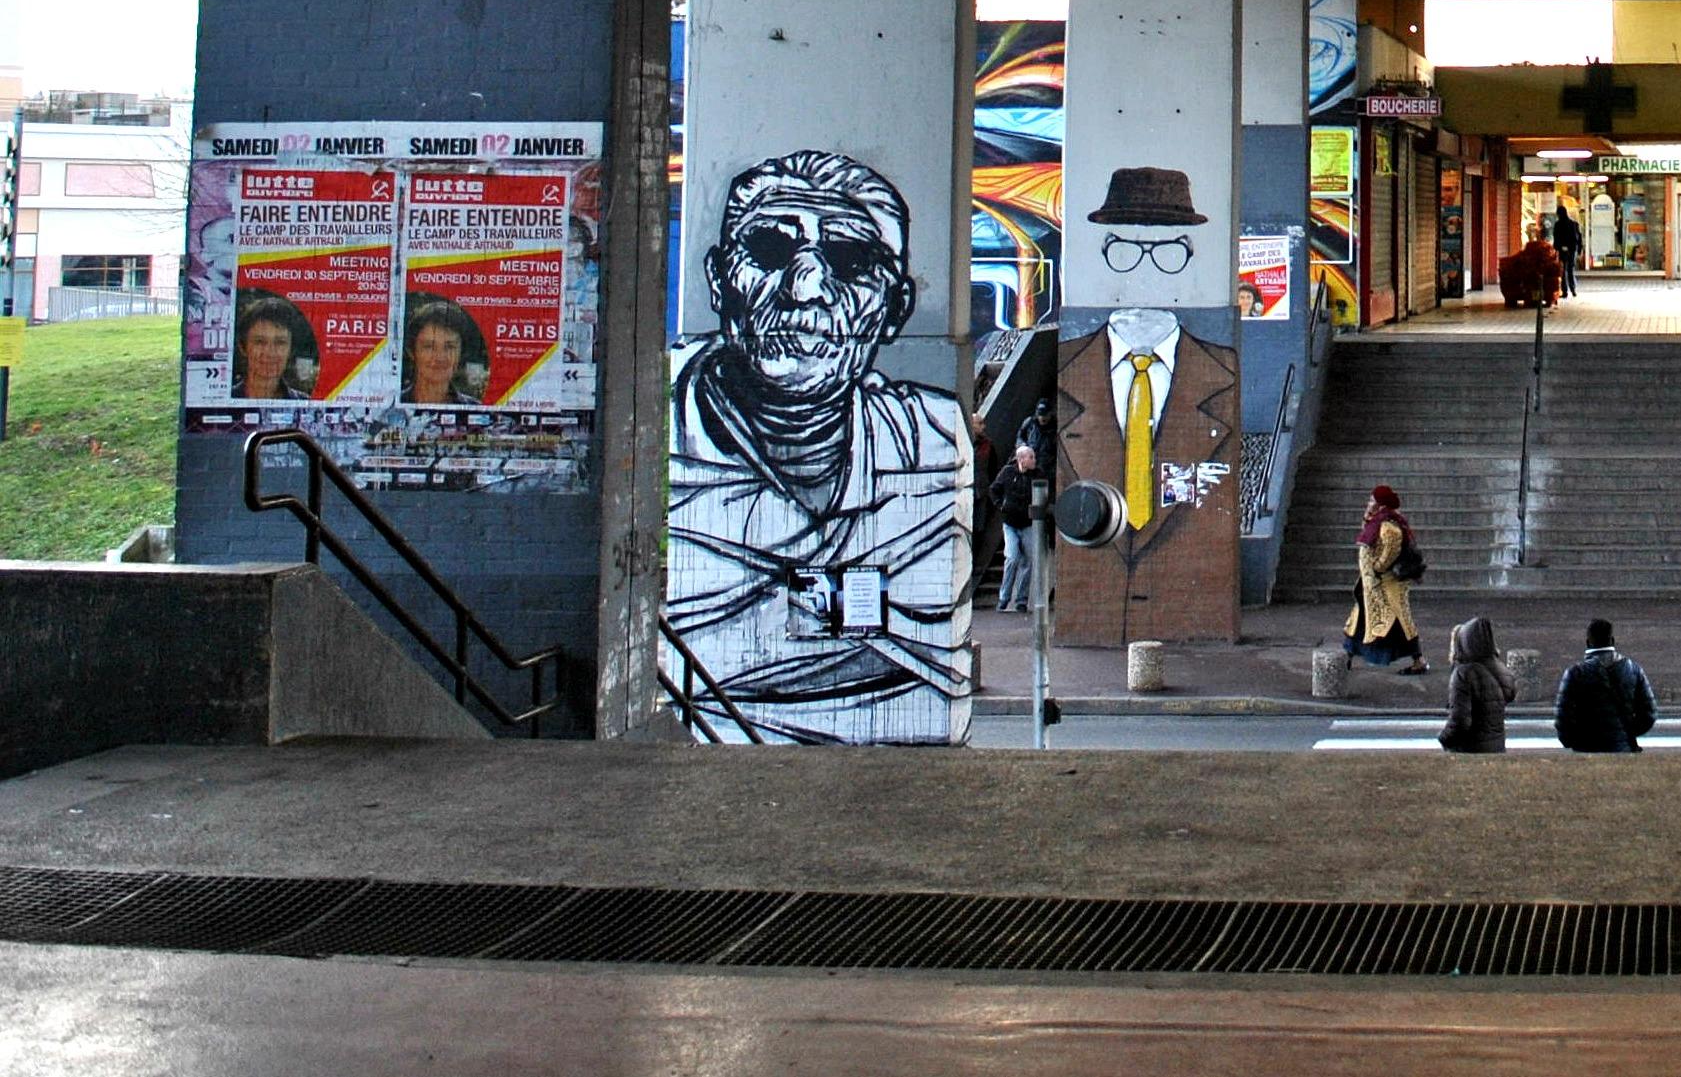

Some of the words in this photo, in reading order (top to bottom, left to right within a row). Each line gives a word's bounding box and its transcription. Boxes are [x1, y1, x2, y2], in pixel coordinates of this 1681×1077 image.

[1371, 99, 1437, 114] BOUCHERIE
[212, 138, 279, 156] SAMEDI
[315, 137, 384, 156] JANVIER
[409, 137, 477, 156] SAMEDI
[481, 134, 510, 155] 02
[512, 137, 584, 156] JANVIER
[1601, 157, 1680, 172] PHARMACIE
[246, 175, 314, 188] lutte
[415, 179, 484, 192] lutte
[240, 205, 291, 223] FAIRE
[297, 205, 392, 223] ENTENDRE
[409, 209, 460, 226] FAIRE
[467, 209, 563, 226] ENTENDRE
[239, 225, 253, 235] LE
[255, 225, 286, 235] CAMP
[289, 225, 310, 235] DES
[314, 224, 392, 235] TRAVAILLEURS
[408, 229, 421, 239] LE
[424, 229, 455, 239] CAMP
[459, 229, 480, 239] DES
[484, 229, 563, 239] TRAVAILLEURS
[239, 237, 260, 246] AVEC
[408, 241, 431, 250] AVEC
[330, 256, 389, 267] MEETING
[500, 260, 560, 271] MEETING
[244, 269, 301, 280] VENDREDI
[303, 270, 317, 280] 30
[319, 270, 389, 281] SEPTEMBRE
[413, 273, 470, 284] VENDREDI
[473, 274, 486, 284] 30
[488, 275, 559, 285] SEPTEMBRE
[357, 282, 388, 291] 20h30
[527, 286, 559, 295] 20h30
[326, 319, 386, 334] PARIS
[496, 325, 557, 339] PARIS
